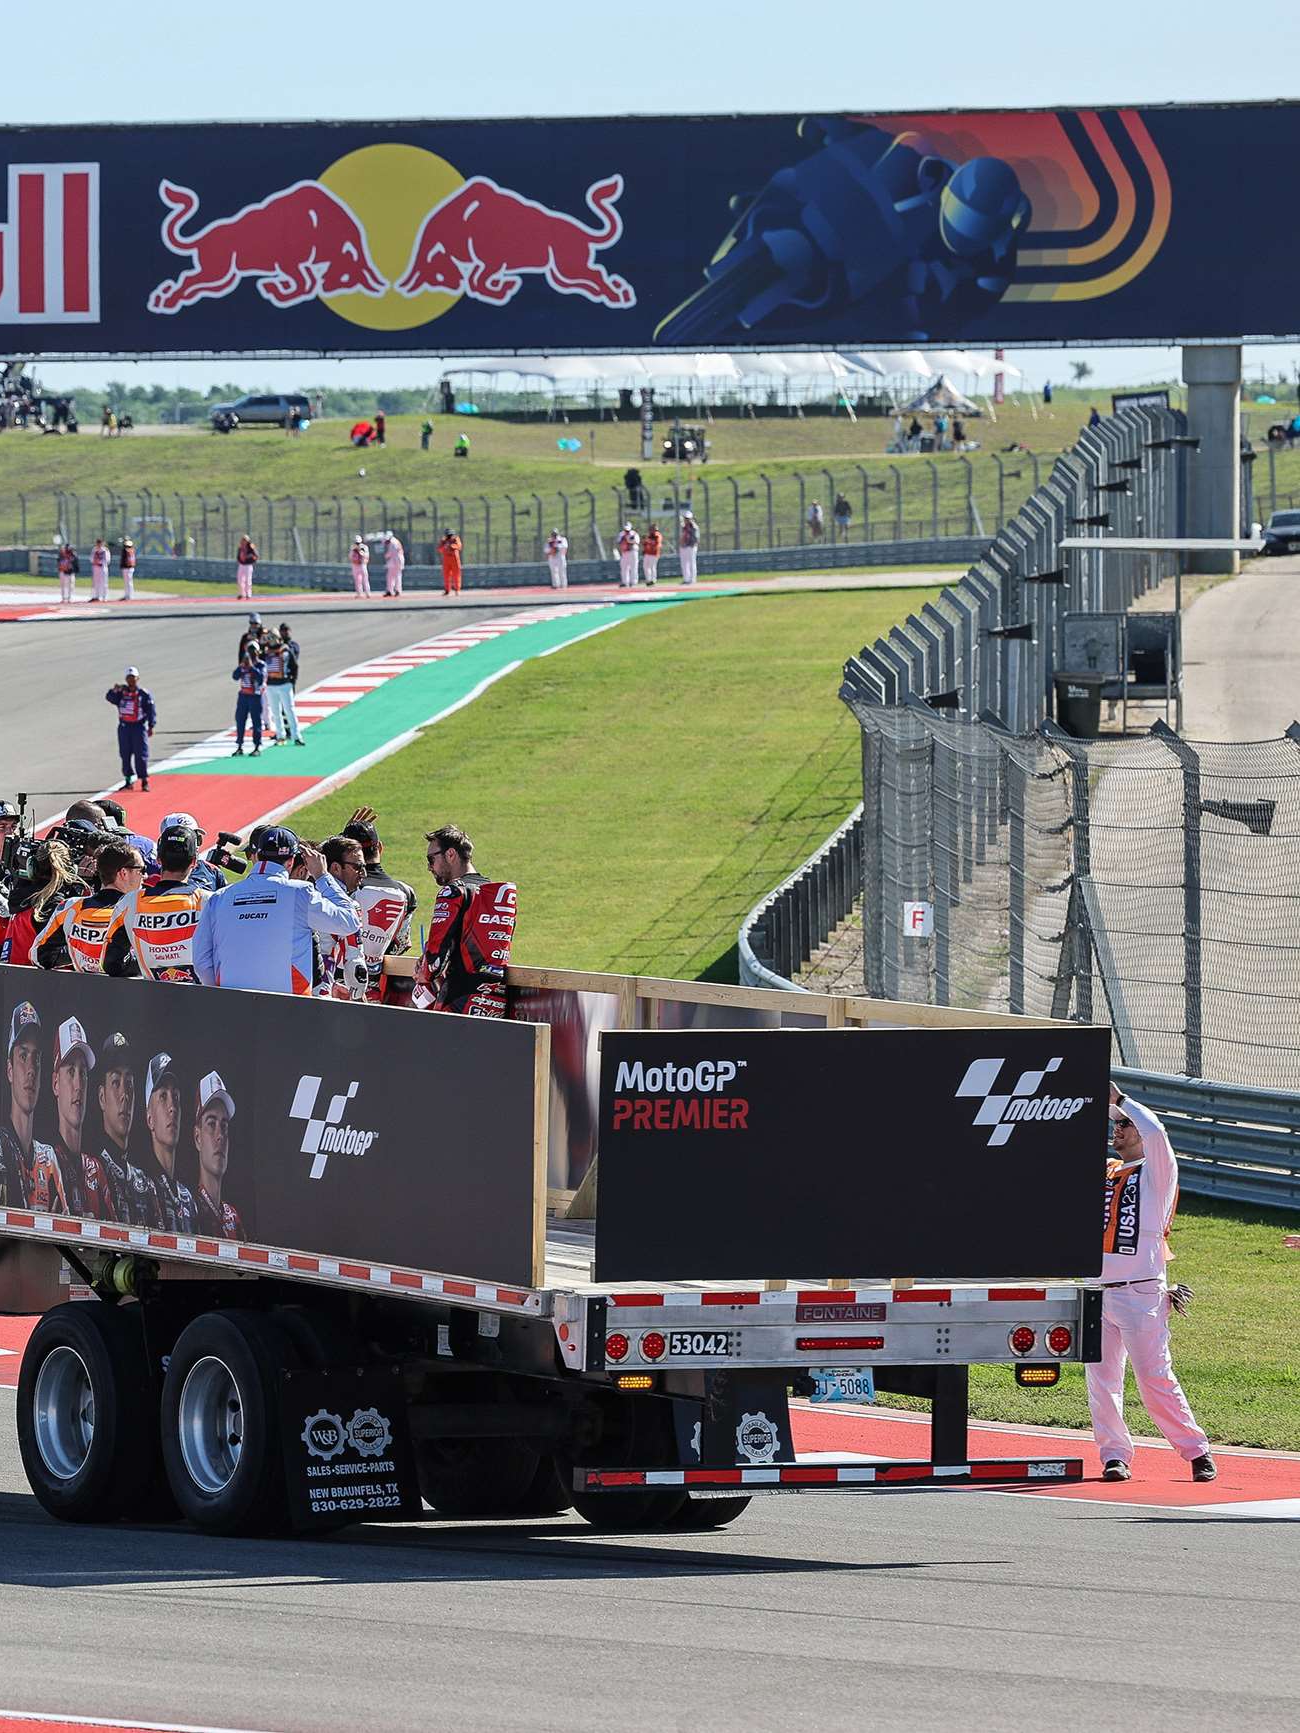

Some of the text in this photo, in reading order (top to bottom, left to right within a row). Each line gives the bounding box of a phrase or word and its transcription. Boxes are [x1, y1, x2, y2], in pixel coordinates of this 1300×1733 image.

[138, 911, 200, 929] REPSOL
[238, 912, 269, 920] DUCATI
[912, 911, 925, 929] F
[149, 944, 188, 954] HONDA
[612, 1099, 750, 1131] PREMIER
[1118, 1184, 1138, 1238] USA23
[803, 1306, 881, 1320] FONTAINE
[671, 1334, 728, 1354] 53042
[312, 1430, 338, 1445] W&B
[354, 1428, 384, 1438] SUPERIOR
[743, 1433, 772, 1444] SUPERIOR
[309, 1483, 399, 1499] NEW BRAUNFELS, TX
[311, 1496, 401, 1512] 830-629-2822
